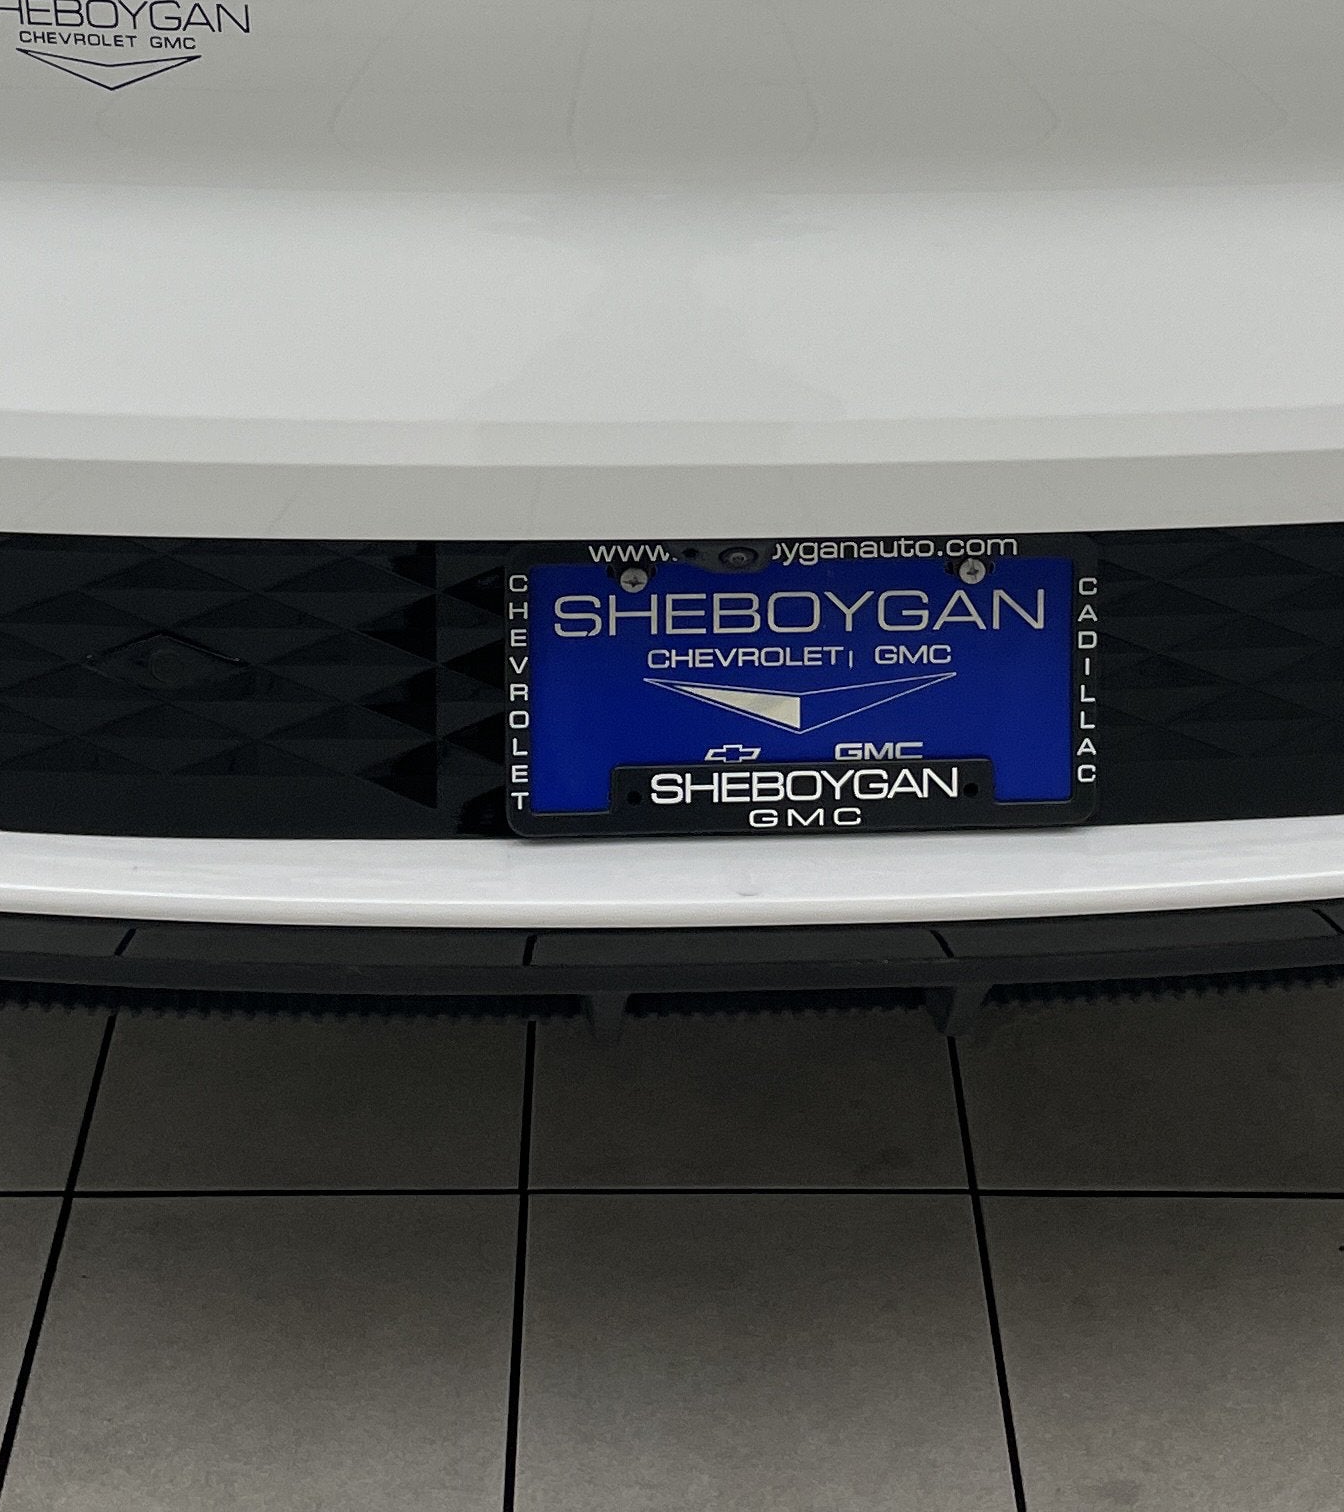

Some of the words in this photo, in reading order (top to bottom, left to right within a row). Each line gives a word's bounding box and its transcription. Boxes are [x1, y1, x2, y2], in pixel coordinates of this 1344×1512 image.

[19, 31, 137, 48] CHEVROLET
[150, 36, 196, 50] GMC
[554, 589, 1045, 637] SHEBOYGAN
[874, 645, 952, 665] GMC
[508, 574, 530, 811] CHEVROLET
[1078, 577, 1097, 784] CADILLAC
[835, 741, 923, 761] GMC
[650, 767, 958, 804] SHEBOYGAN
[749, 807, 861, 828] GMC
